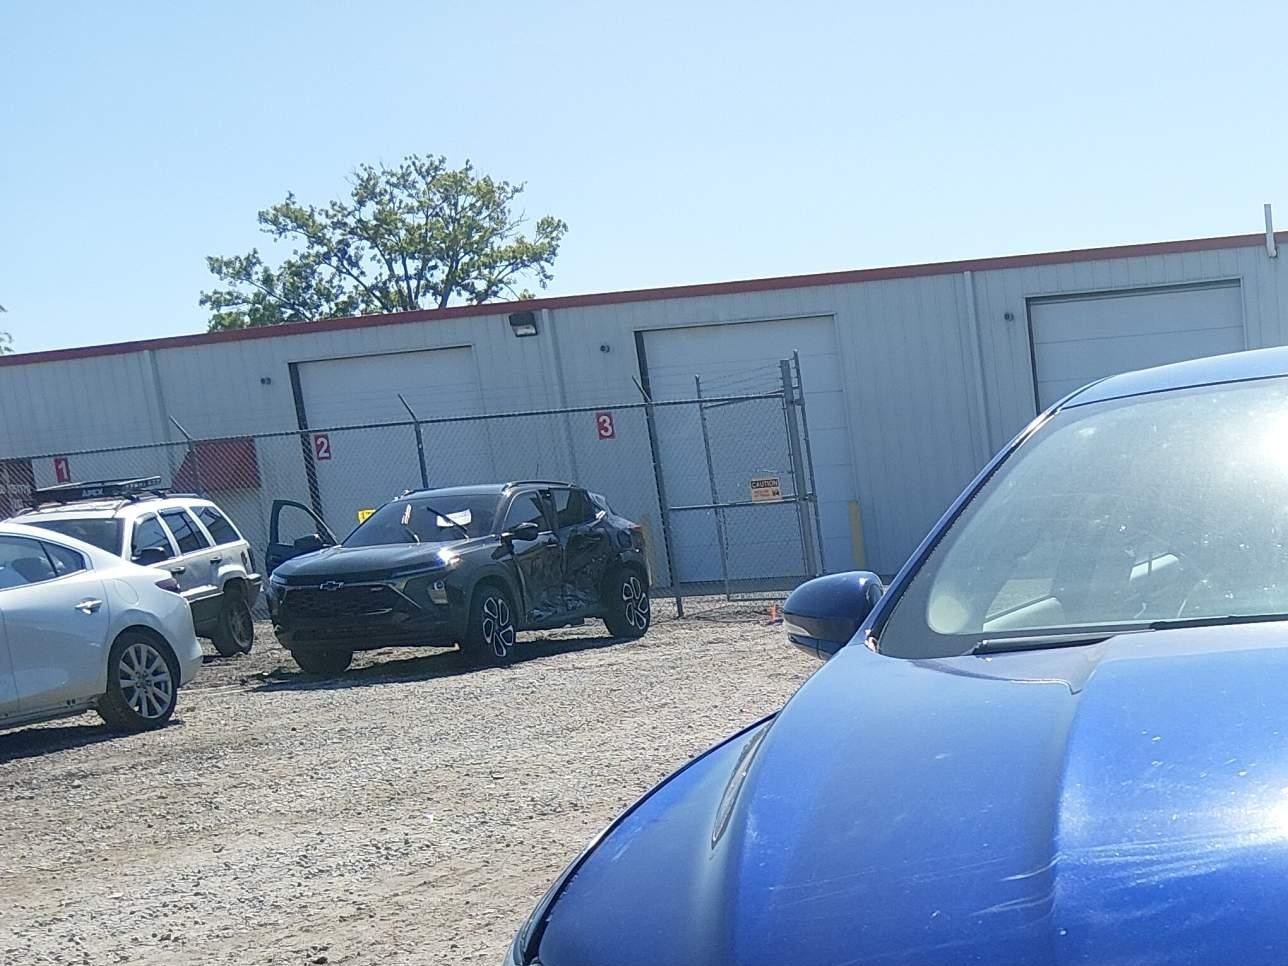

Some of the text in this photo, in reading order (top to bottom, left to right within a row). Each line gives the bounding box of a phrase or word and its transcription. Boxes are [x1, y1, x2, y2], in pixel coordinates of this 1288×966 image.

[598, 415, 613, 437] 3
[316, 437, 330, 458] 2
[57, 459, 69, 481] 1
